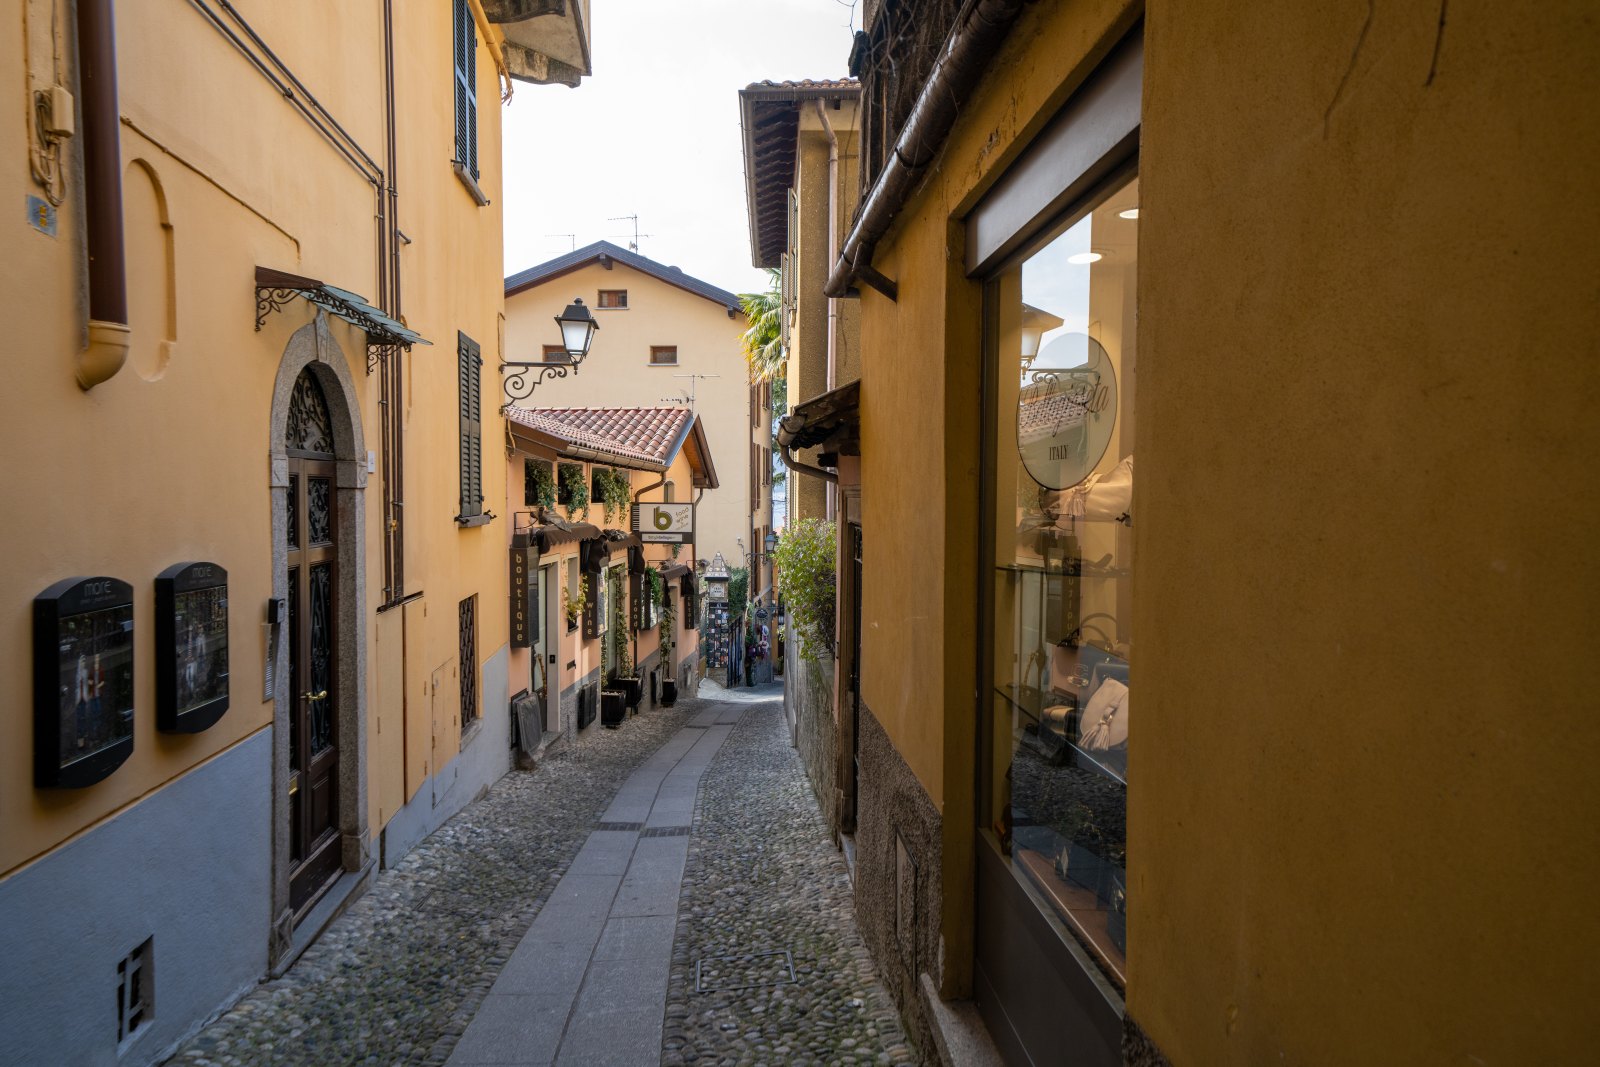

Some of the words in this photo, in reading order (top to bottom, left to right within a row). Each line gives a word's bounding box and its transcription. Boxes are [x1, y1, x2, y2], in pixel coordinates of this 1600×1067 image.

[1049, 444, 1069, 461] ITALY
[675, 506, 689, 517] food
[515, 553, 523, 641] boutique
[586, 602, 594, 635] wine
